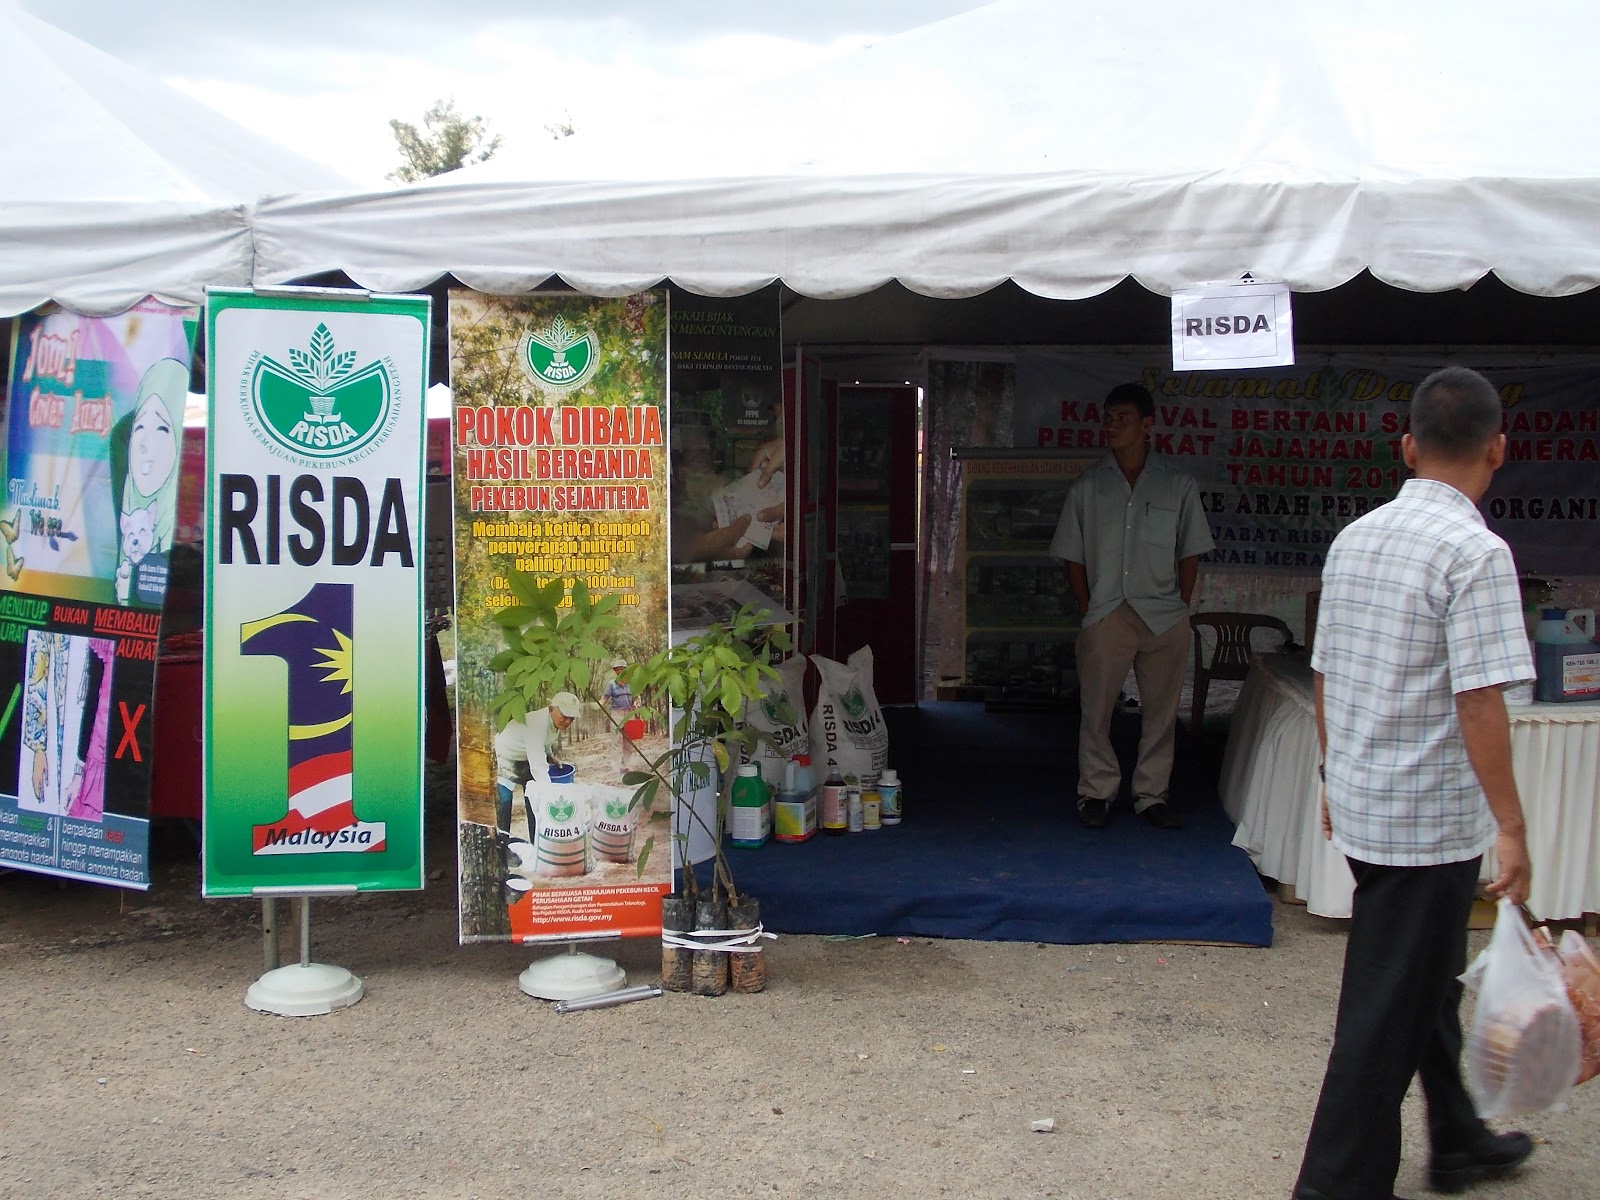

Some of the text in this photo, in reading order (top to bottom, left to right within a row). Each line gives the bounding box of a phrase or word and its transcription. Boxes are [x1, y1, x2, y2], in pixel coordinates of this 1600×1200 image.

[678, 324, 777, 338] MENGUNTUNGKAN
[1186, 315, 1271, 336] RISDA
[671, 352, 691, 360] NAM
[692, 352, 729, 361] SEMULA
[543, 365, 577, 380] RISDA
[1135, 367, 1322, 400] Selamat
[240, 350, 402, 470] PIHAK BERKUASA KEMAJUAN PEKEBUN KECIL PERUSAHAAN GETAH
[456, 406, 663, 447] POKOK DIBAJA
[1231, 409, 1367, 433] BERTANI
[289, 420, 358, 447] RISDA
[1227, 436, 1373, 460] JAJAHAN
[467, 448, 653, 480] HASIL BERGANDA
[1226, 464, 1333, 488] TAHUN
[471, 485, 650, 511] PEKEBUN SEJAHTERA
[1235, 492, 1311, 516] ARAH
[219, 473, 415, 568] RISDA
[472, 520, 651, 538] Membaja ketika tempoh
[1212, 525, 1338, 544] JABAT RISD
[488, 538, 635, 556] penyerapan nutrien
[1200, 548, 1325, 567] ANAH MERA
[515, 555, 609, 573] paling tinggi
[490, 577, 511, 591] (Da
[586, 575, 608, 589] 100
[610, 575, 635, 588] hari
[54, 606, 89, 625] BUKAN
[0, 622, 27, 644] URAT
[823, 704, 838, 767] RISDA 4
[0, 809, 18, 825] kaian
[598, 821, 628, 833] RISDA 4
[62, 821, 103, 840] berpakaian
[264, 823, 372, 849] Malaysia
[544, 827, 580, 838] RISDA 4
[61, 838, 142, 864] hingga menampakkan
[61, 856, 86, 871] bentuk
[119, 866, 144, 881] badan
[532, 897, 573, 905] PERUSAHAAN
[583, 888, 616, 896] KEMAJUAN
[616, 887, 643, 895] PEKEBUN
